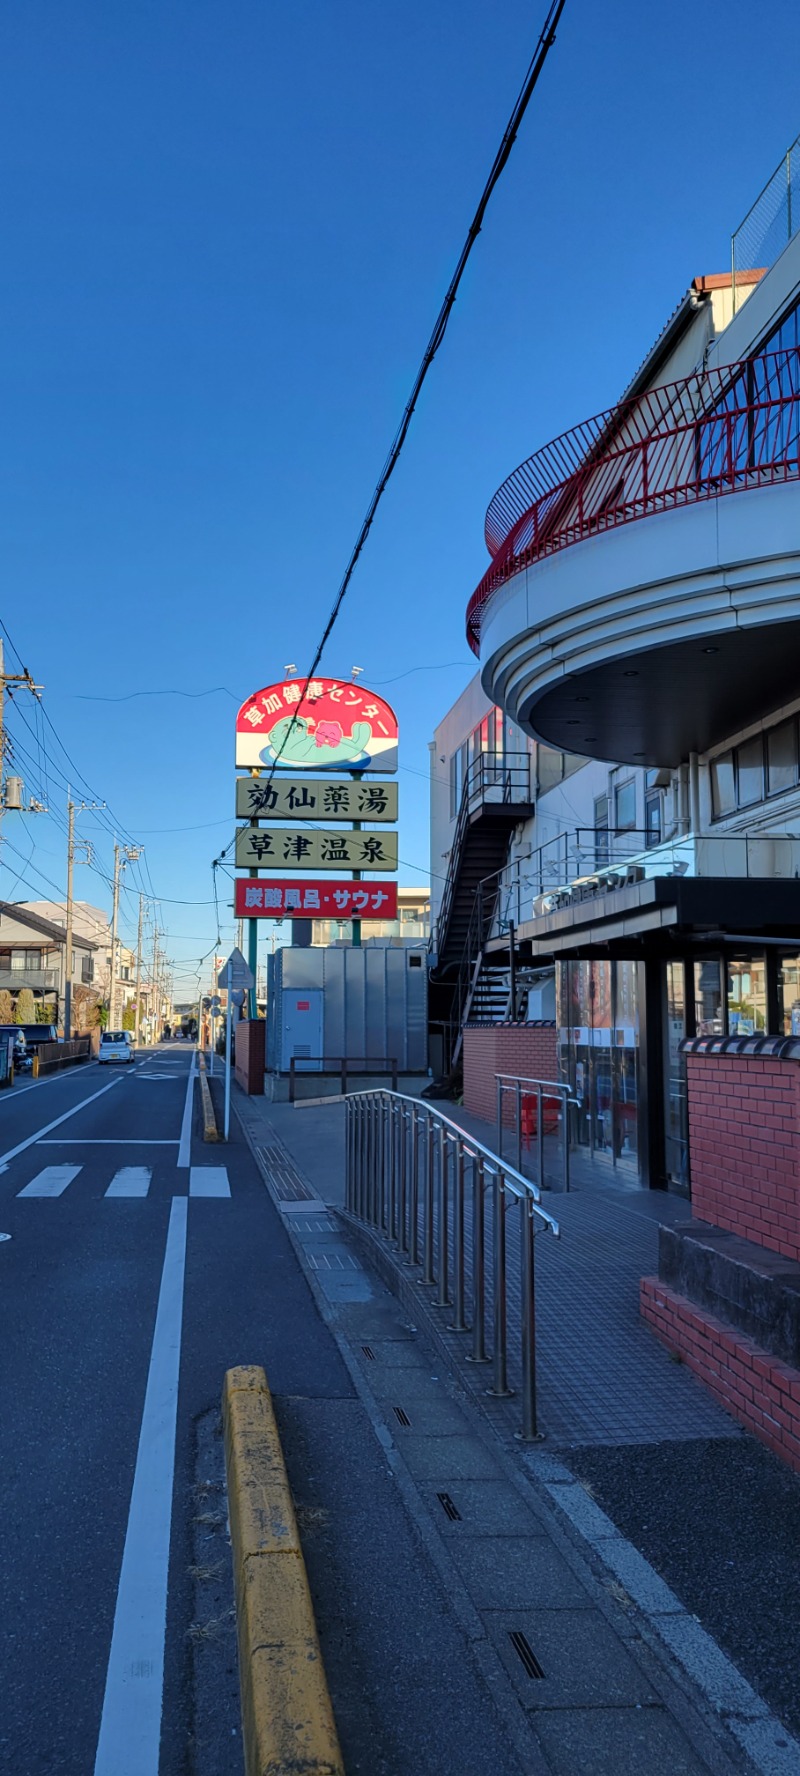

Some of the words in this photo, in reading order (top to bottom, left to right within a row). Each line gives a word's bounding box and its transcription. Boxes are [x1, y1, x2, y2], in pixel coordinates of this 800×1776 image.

[243, 681, 389, 735] 草加健康センター
[247, 784, 389, 814] 効仙薬湯
[246, 834, 389, 864] 草津温泉
[245, 887, 388, 909] 炭酸風呂・サウナ
